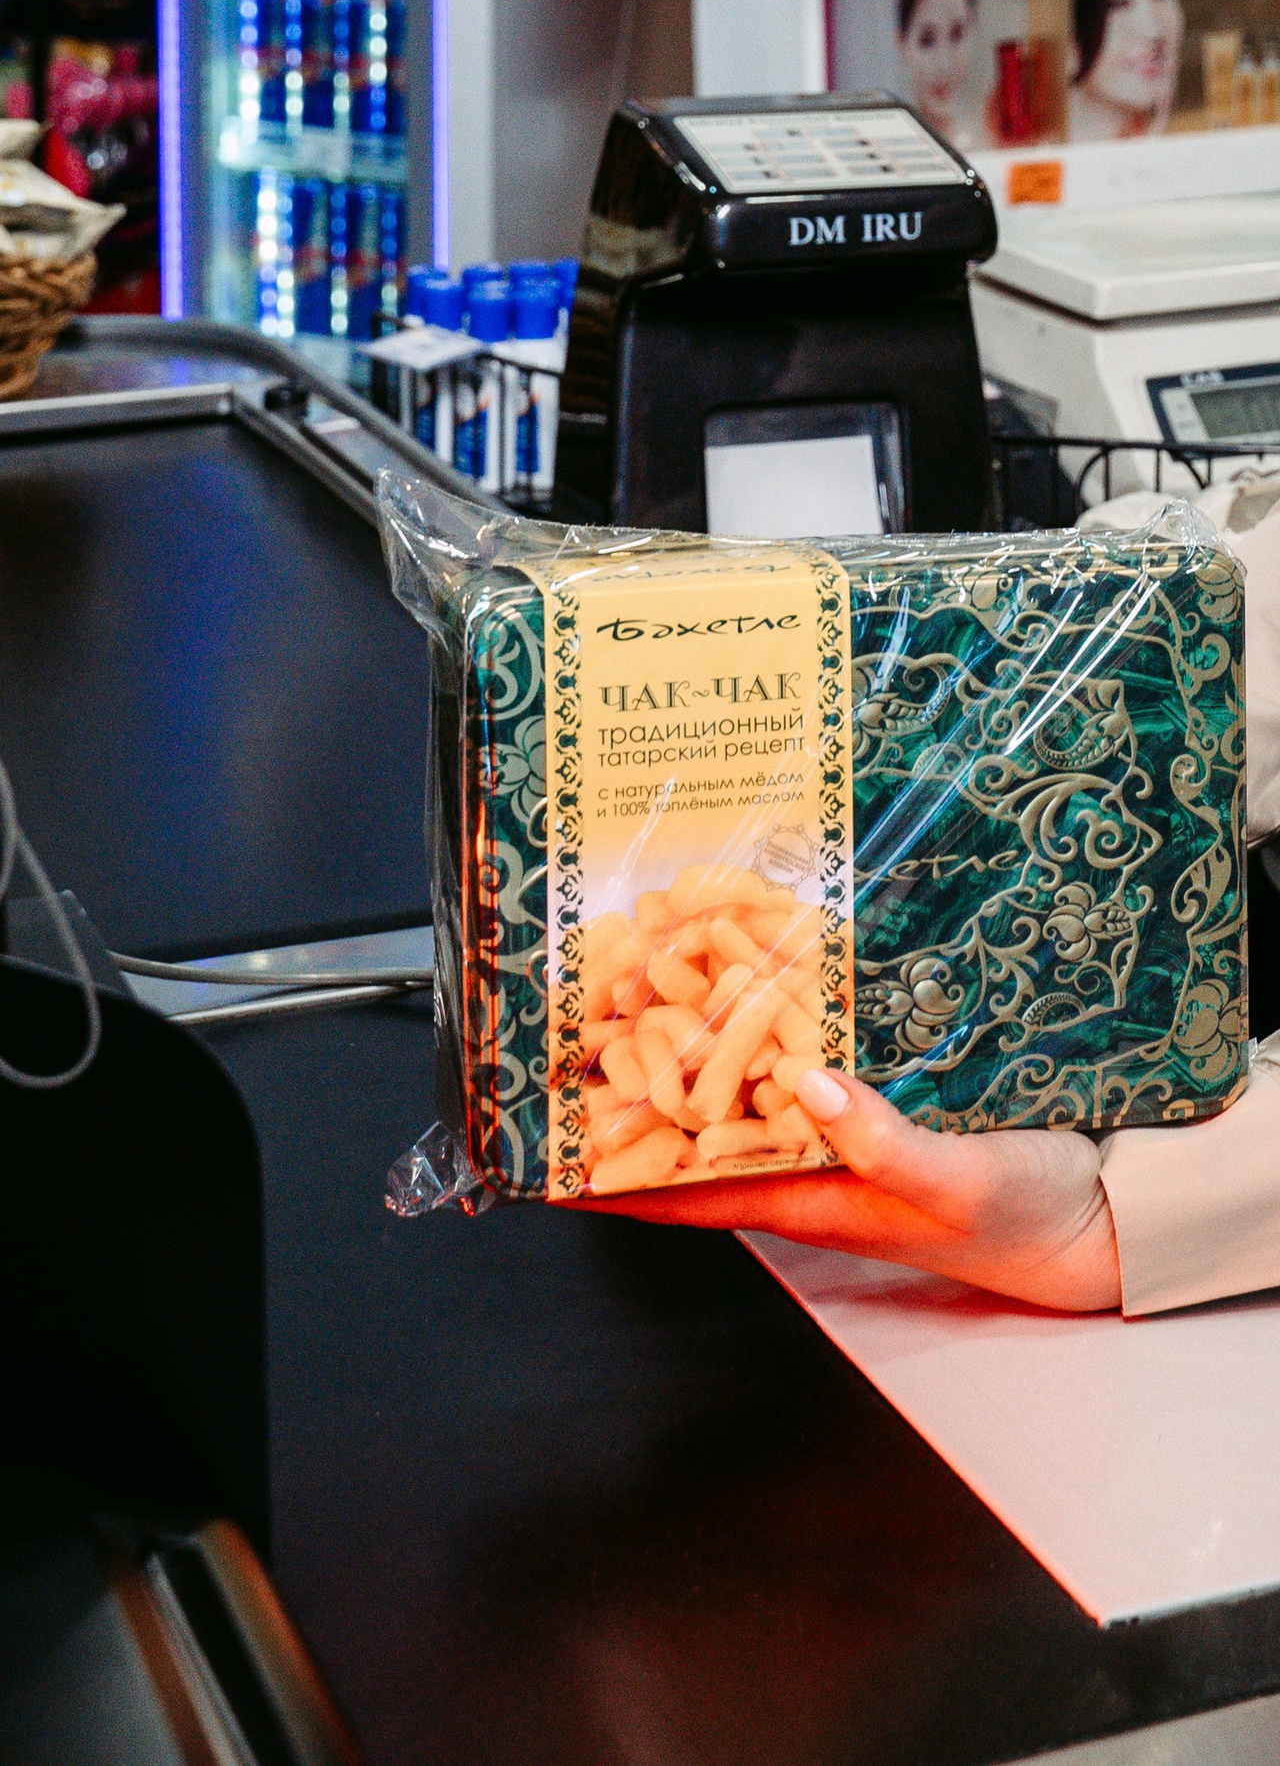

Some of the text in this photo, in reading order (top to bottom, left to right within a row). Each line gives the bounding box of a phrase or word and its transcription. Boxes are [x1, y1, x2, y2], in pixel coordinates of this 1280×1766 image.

[788, 211, 923, 247] DM IRU
[597, 707, 804, 749] традиционный
[597, 736, 806, 768] татарский рецепт
[598, 771, 804, 800] с натуральным мёдом
[597, 790, 805, 818] и 100% топлёным маслом
